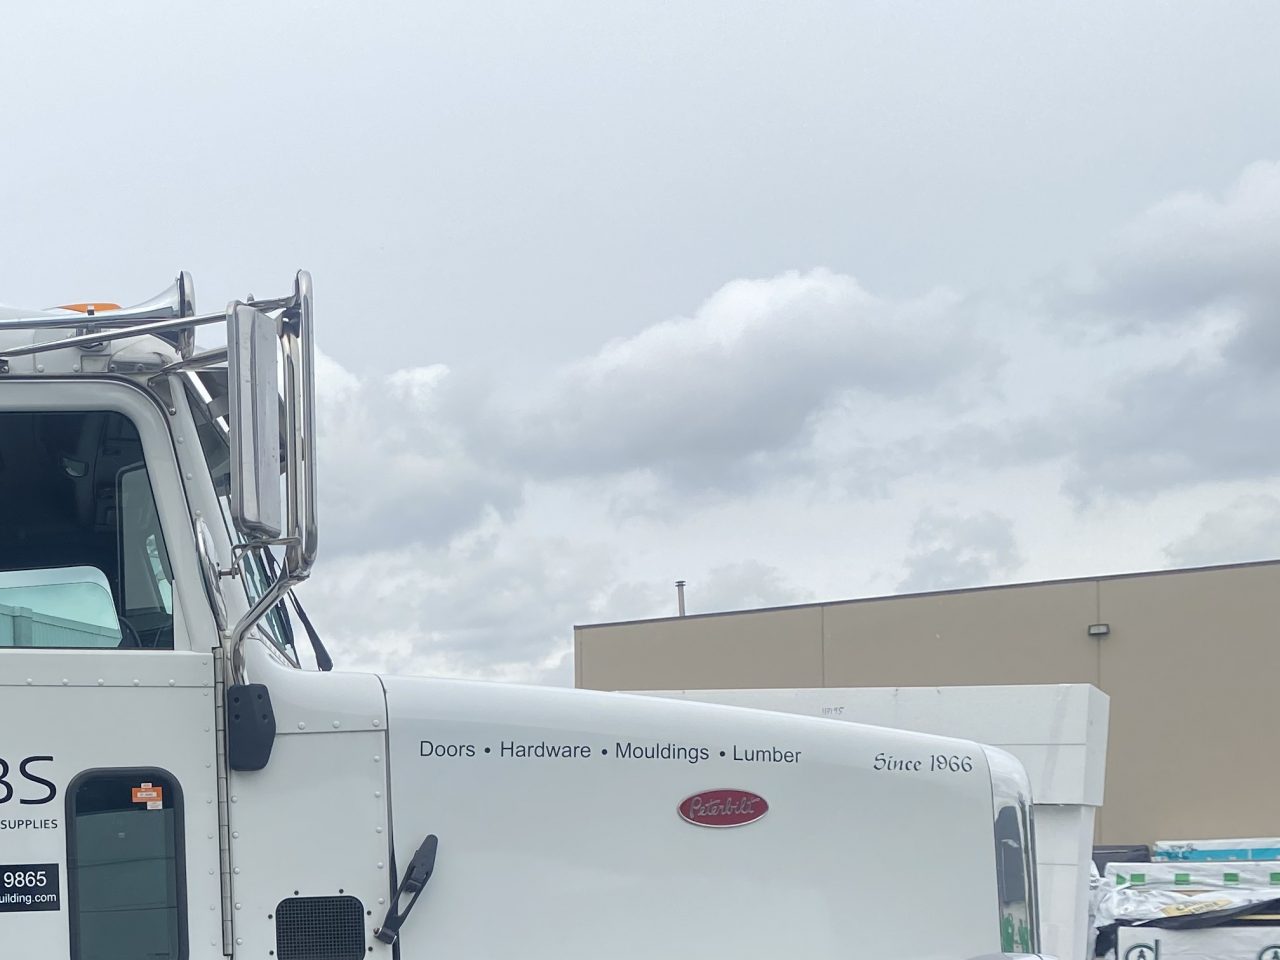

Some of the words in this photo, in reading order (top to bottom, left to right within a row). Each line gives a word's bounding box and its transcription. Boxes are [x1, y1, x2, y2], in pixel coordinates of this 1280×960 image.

[420, 740, 475, 757] Doors
[500, 741, 591, 758] Hardware
[615, 742, 709, 764] Mouldings
[733, 745, 801, 763] Lumber
[873, 752, 922, 771] Since
[930, 754, 973, 772] 1966
[689, 796, 761, 819] Peterbilt
[1, 819, 59, 829] SUPPLIES
[3, 871, 47, 887] 9865
